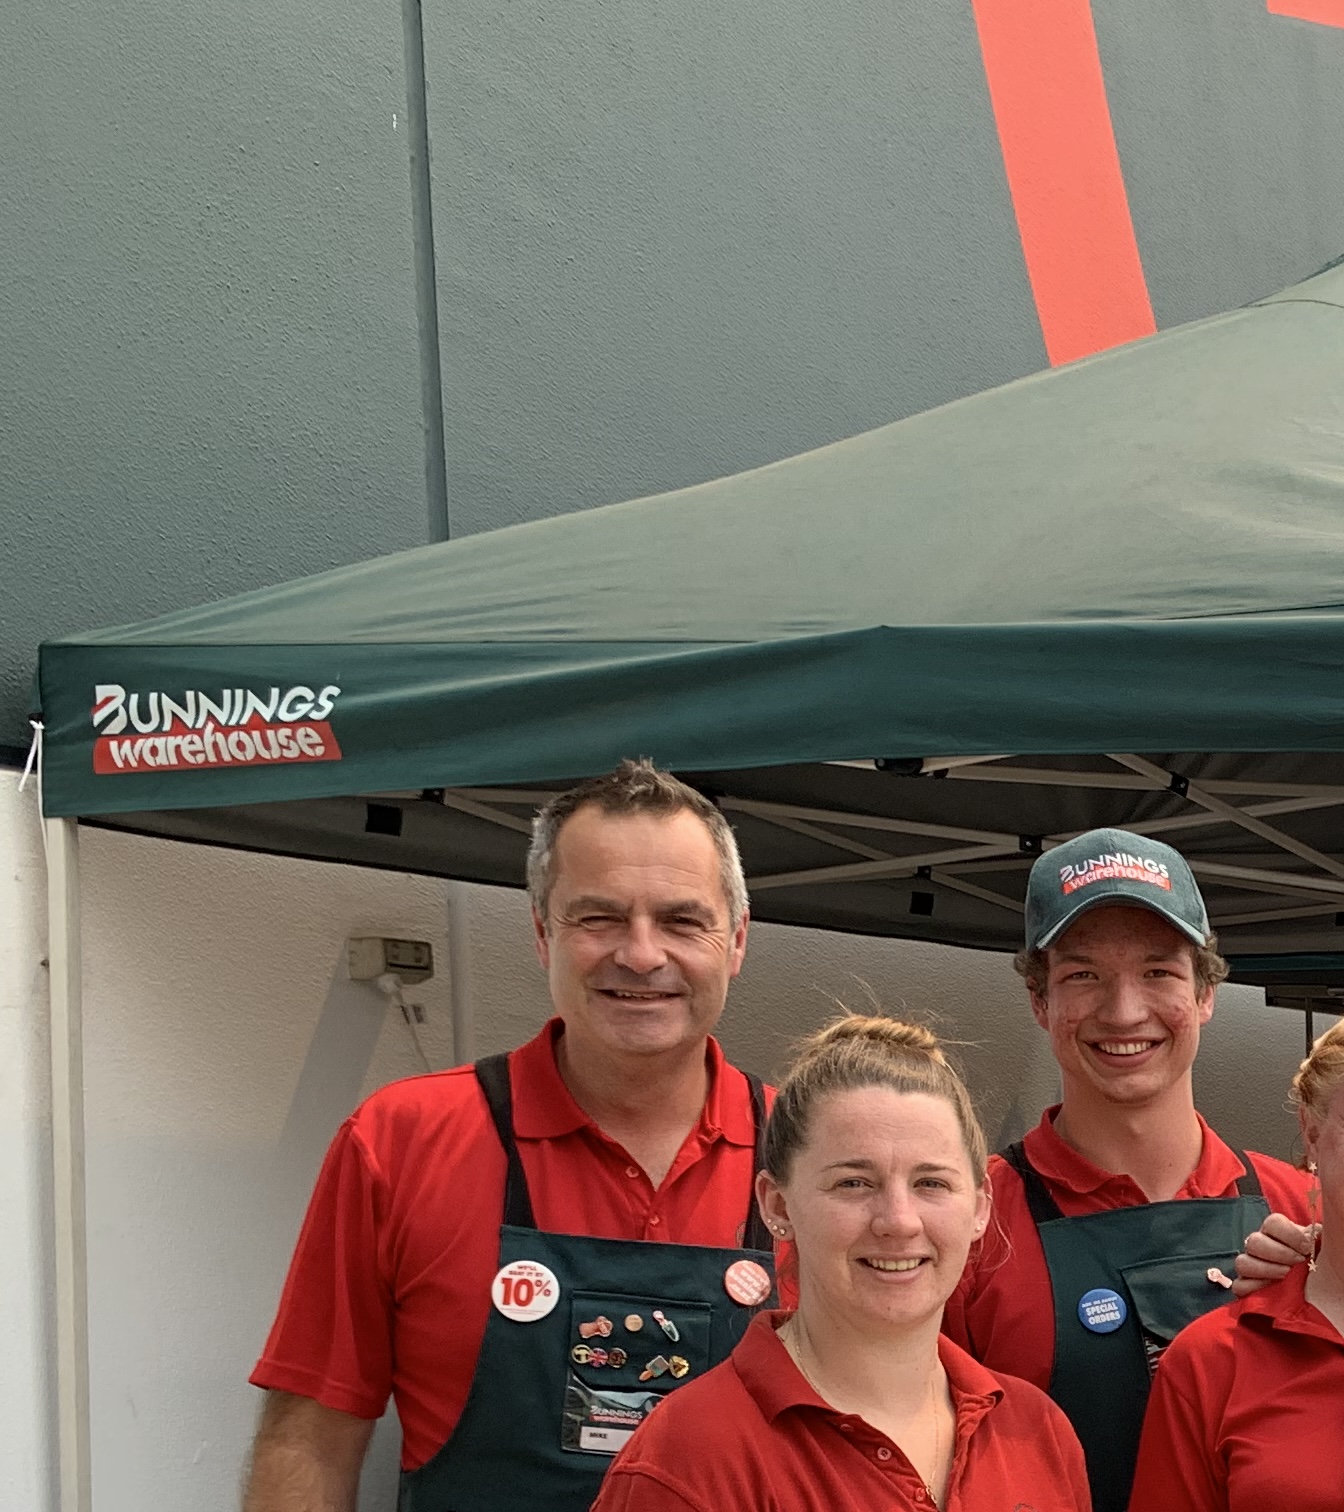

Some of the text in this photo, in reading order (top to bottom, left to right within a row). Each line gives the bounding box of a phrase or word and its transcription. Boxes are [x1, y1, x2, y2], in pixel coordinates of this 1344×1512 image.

[93, 684, 342, 735] BUNNINGS
[109, 723, 325, 769] warehouse
[1060, 852, 1169, 883] BUNNINGS
[1070, 862, 1167, 889] warehouse
[501, 1277, 552, 1308] 10%
[1085, 1302, 1119, 1317] SPECIAL
[1088, 1311, 1121, 1325] ORDERS
